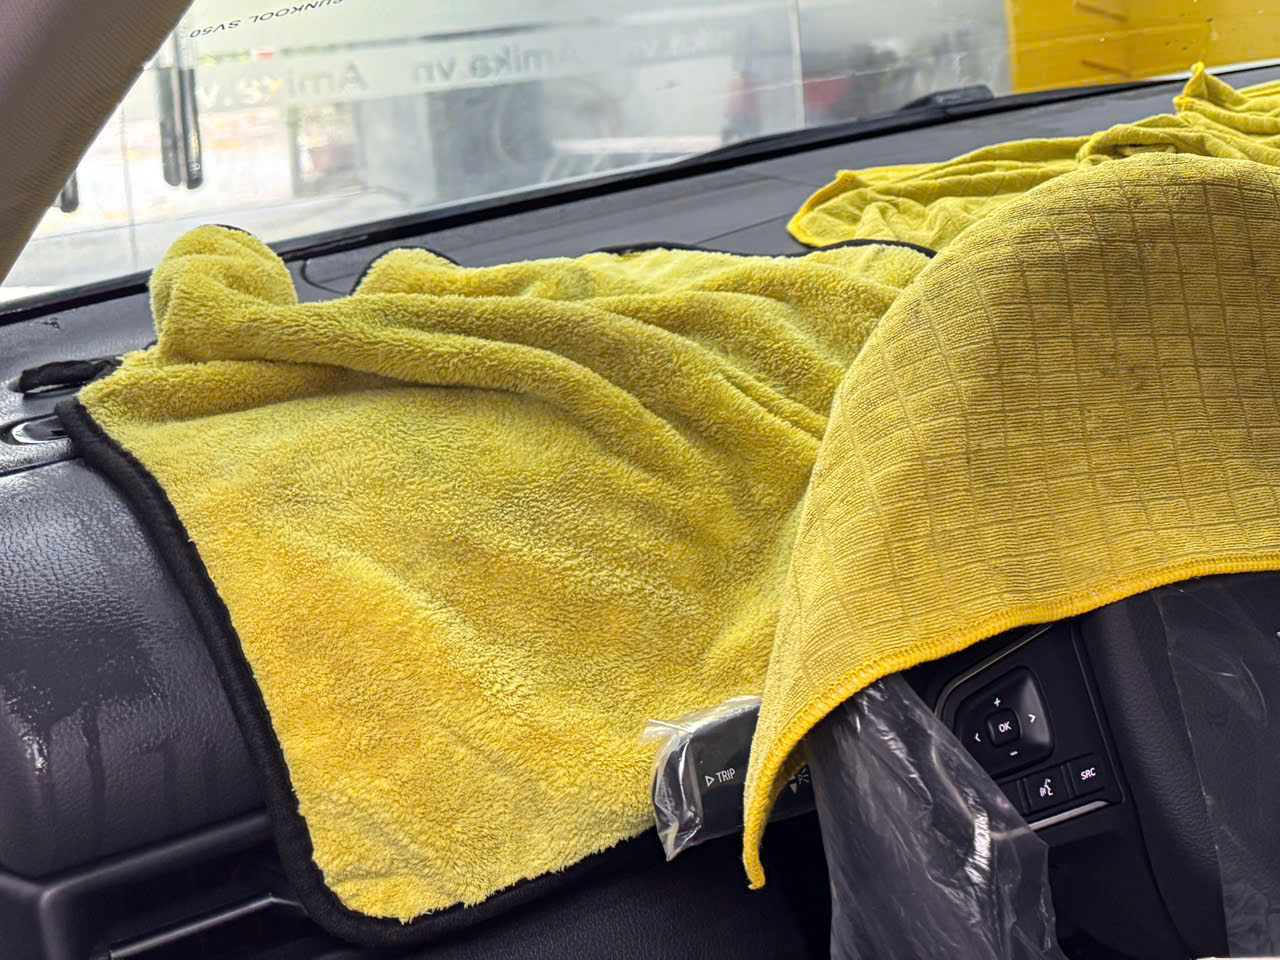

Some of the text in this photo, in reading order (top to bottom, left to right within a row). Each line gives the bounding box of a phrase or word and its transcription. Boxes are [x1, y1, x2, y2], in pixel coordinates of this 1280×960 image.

[189, 19, 241, 39] SV50
[998, 720, 1012, 733] OK
[715, 767, 736, 783] TRIP
[1080, 767, 1096, 781] SRC
